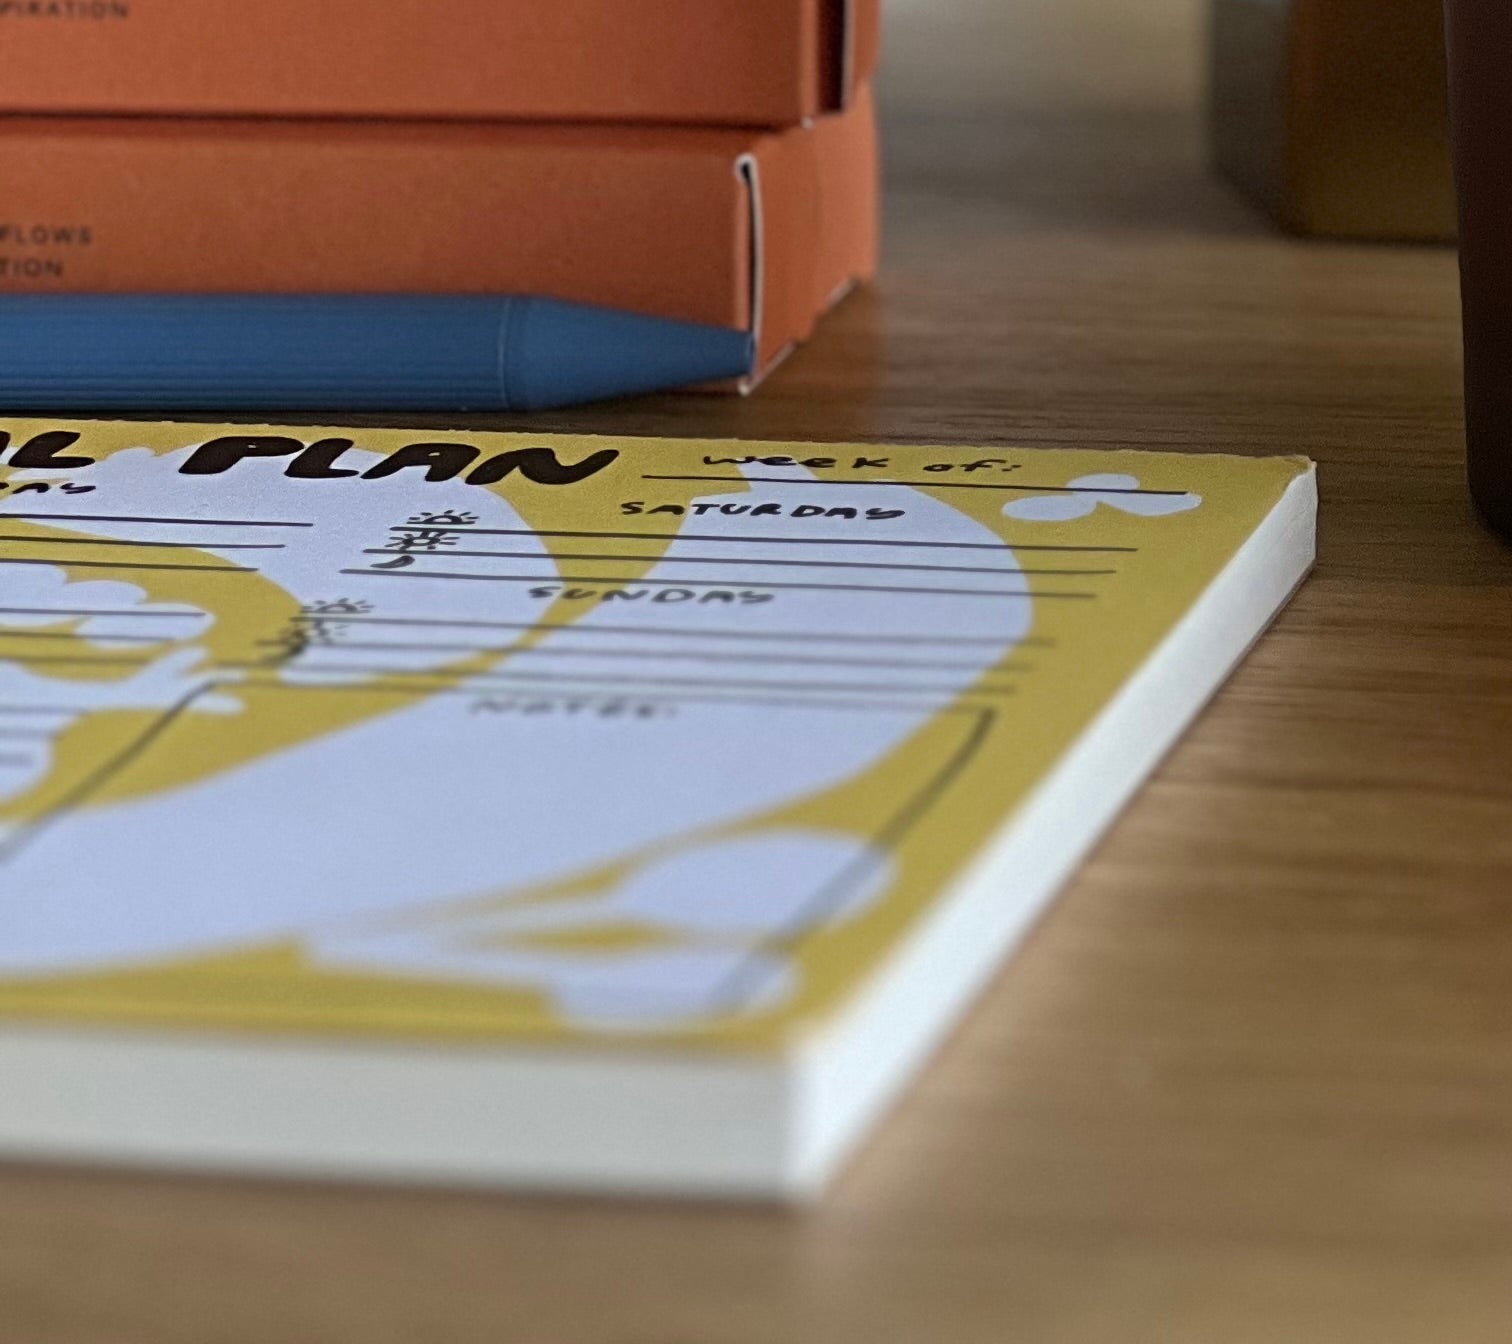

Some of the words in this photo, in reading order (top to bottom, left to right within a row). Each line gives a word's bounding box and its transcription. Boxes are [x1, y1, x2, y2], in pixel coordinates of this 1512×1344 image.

[0, 225, 92, 245] FLOWS
[0, 430, 96, 469] L
[178, 436, 619, 485] PLAN
[703, 455, 890, 470] week
[0, 481, 97, 495] AY
[620, 501, 906, 520] SATURDAY
[527, 585, 775, 604] SUNDAY
